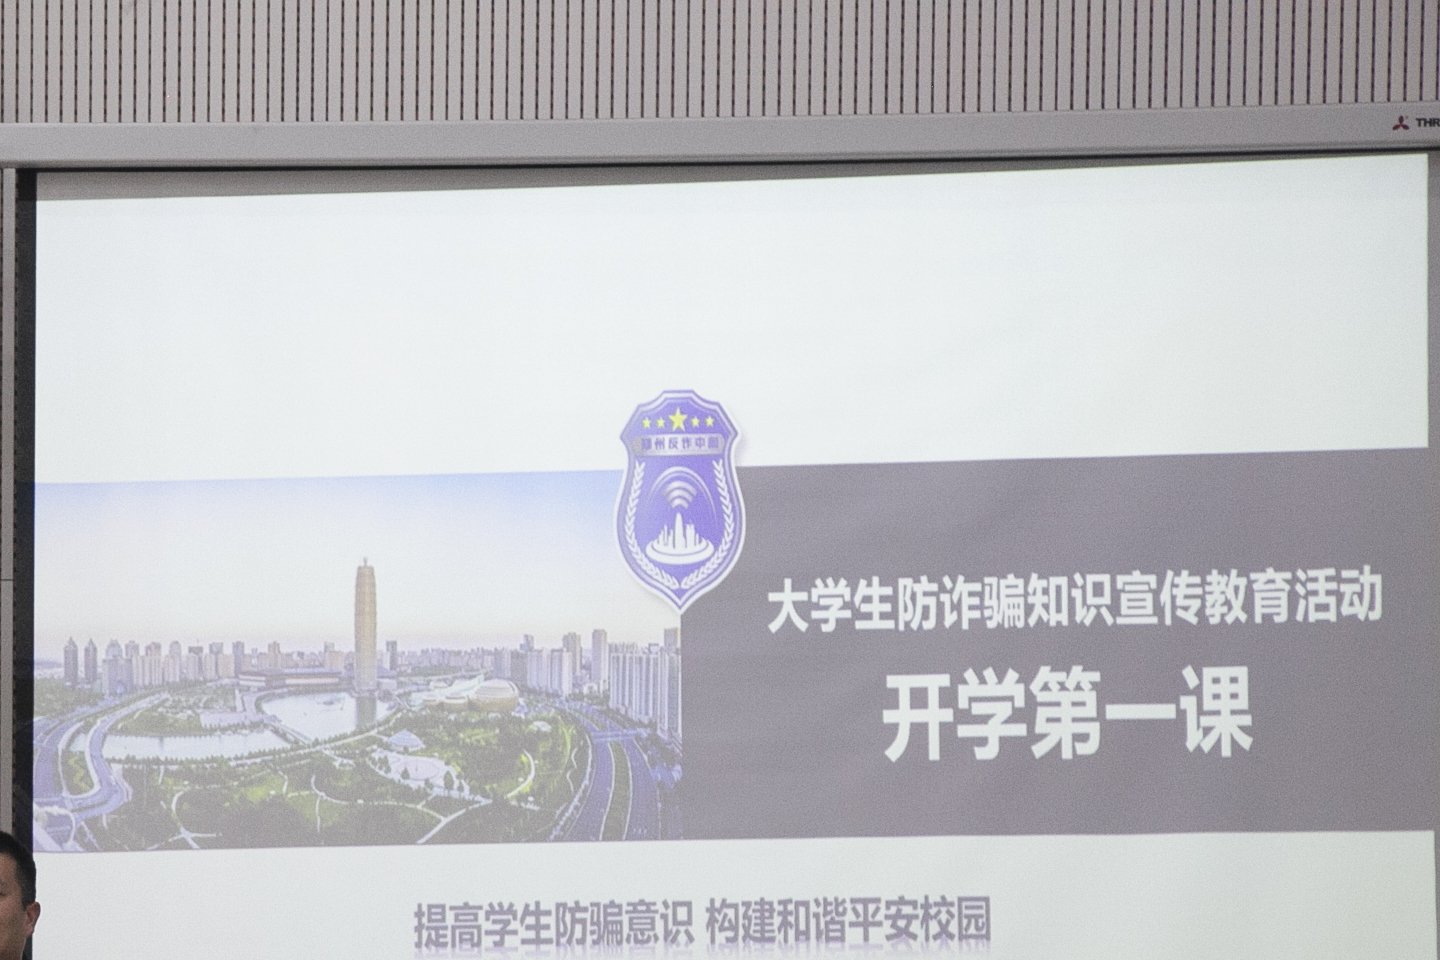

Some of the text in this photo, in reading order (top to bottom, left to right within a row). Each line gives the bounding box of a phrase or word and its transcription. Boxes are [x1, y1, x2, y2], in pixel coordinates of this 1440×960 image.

[767, 564, 1383, 633] 大学生防诈骗知识宣传教育活动
[882, 664, 1254, 762] 开学第一课
[413, 895, 992, 949] 提高学生防骗意识 构建和谐平安校园
